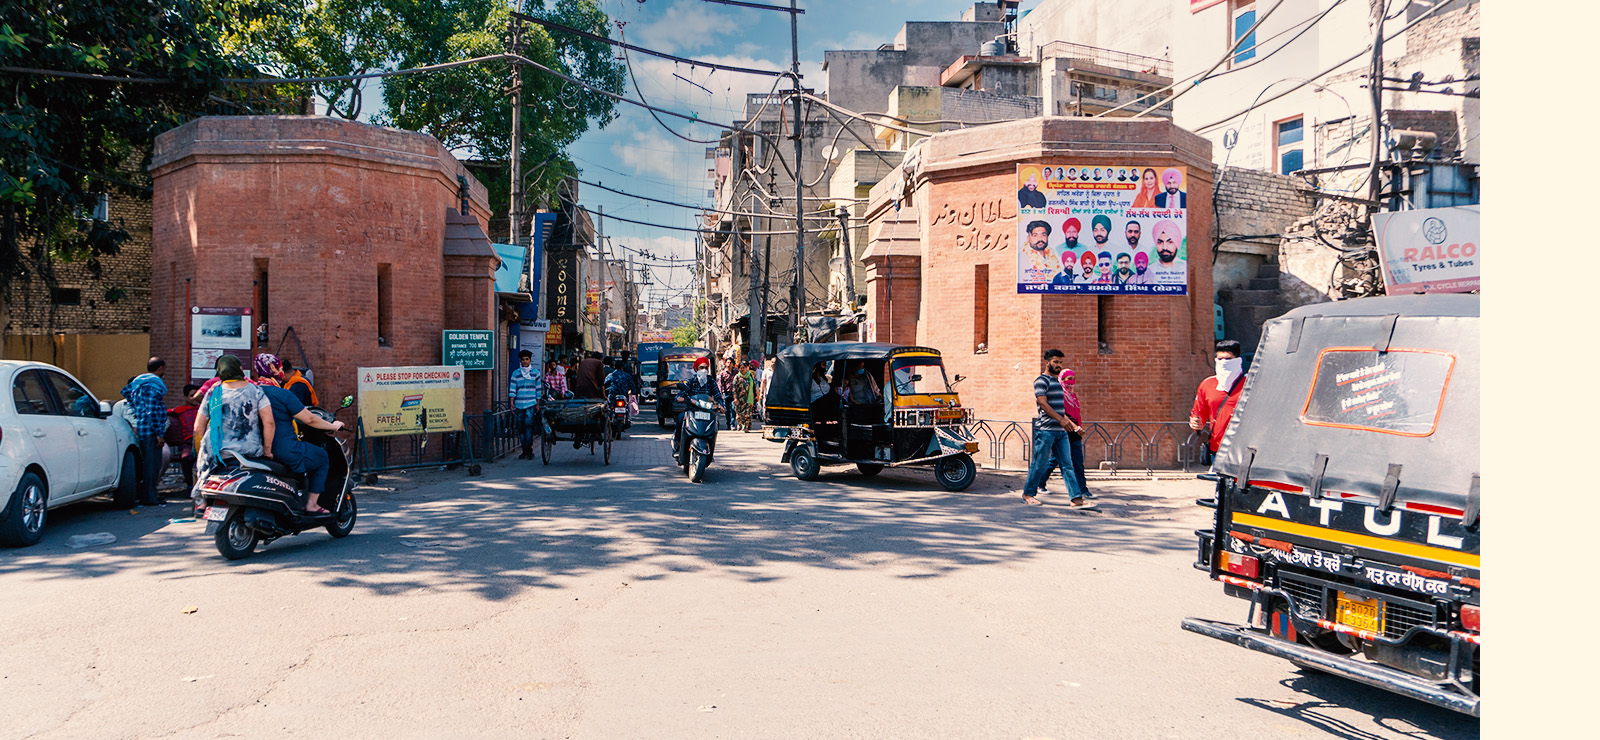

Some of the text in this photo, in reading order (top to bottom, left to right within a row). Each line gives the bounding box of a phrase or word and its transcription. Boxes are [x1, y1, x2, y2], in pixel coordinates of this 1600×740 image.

[1403, 242, 1477, 263] RALCO
[1412, 263, 1436, 272] Tyres
[1447, 260, 1474, 268] Tubes
[397, 372, 411, 380] STOP
[424, 371, 450, 379] CHECKING
[265, 475, 296, 494] HONDA
[1256, 491, 1463, 549] ATUL
[1425, 579, 1448, 594] ਕਰ
